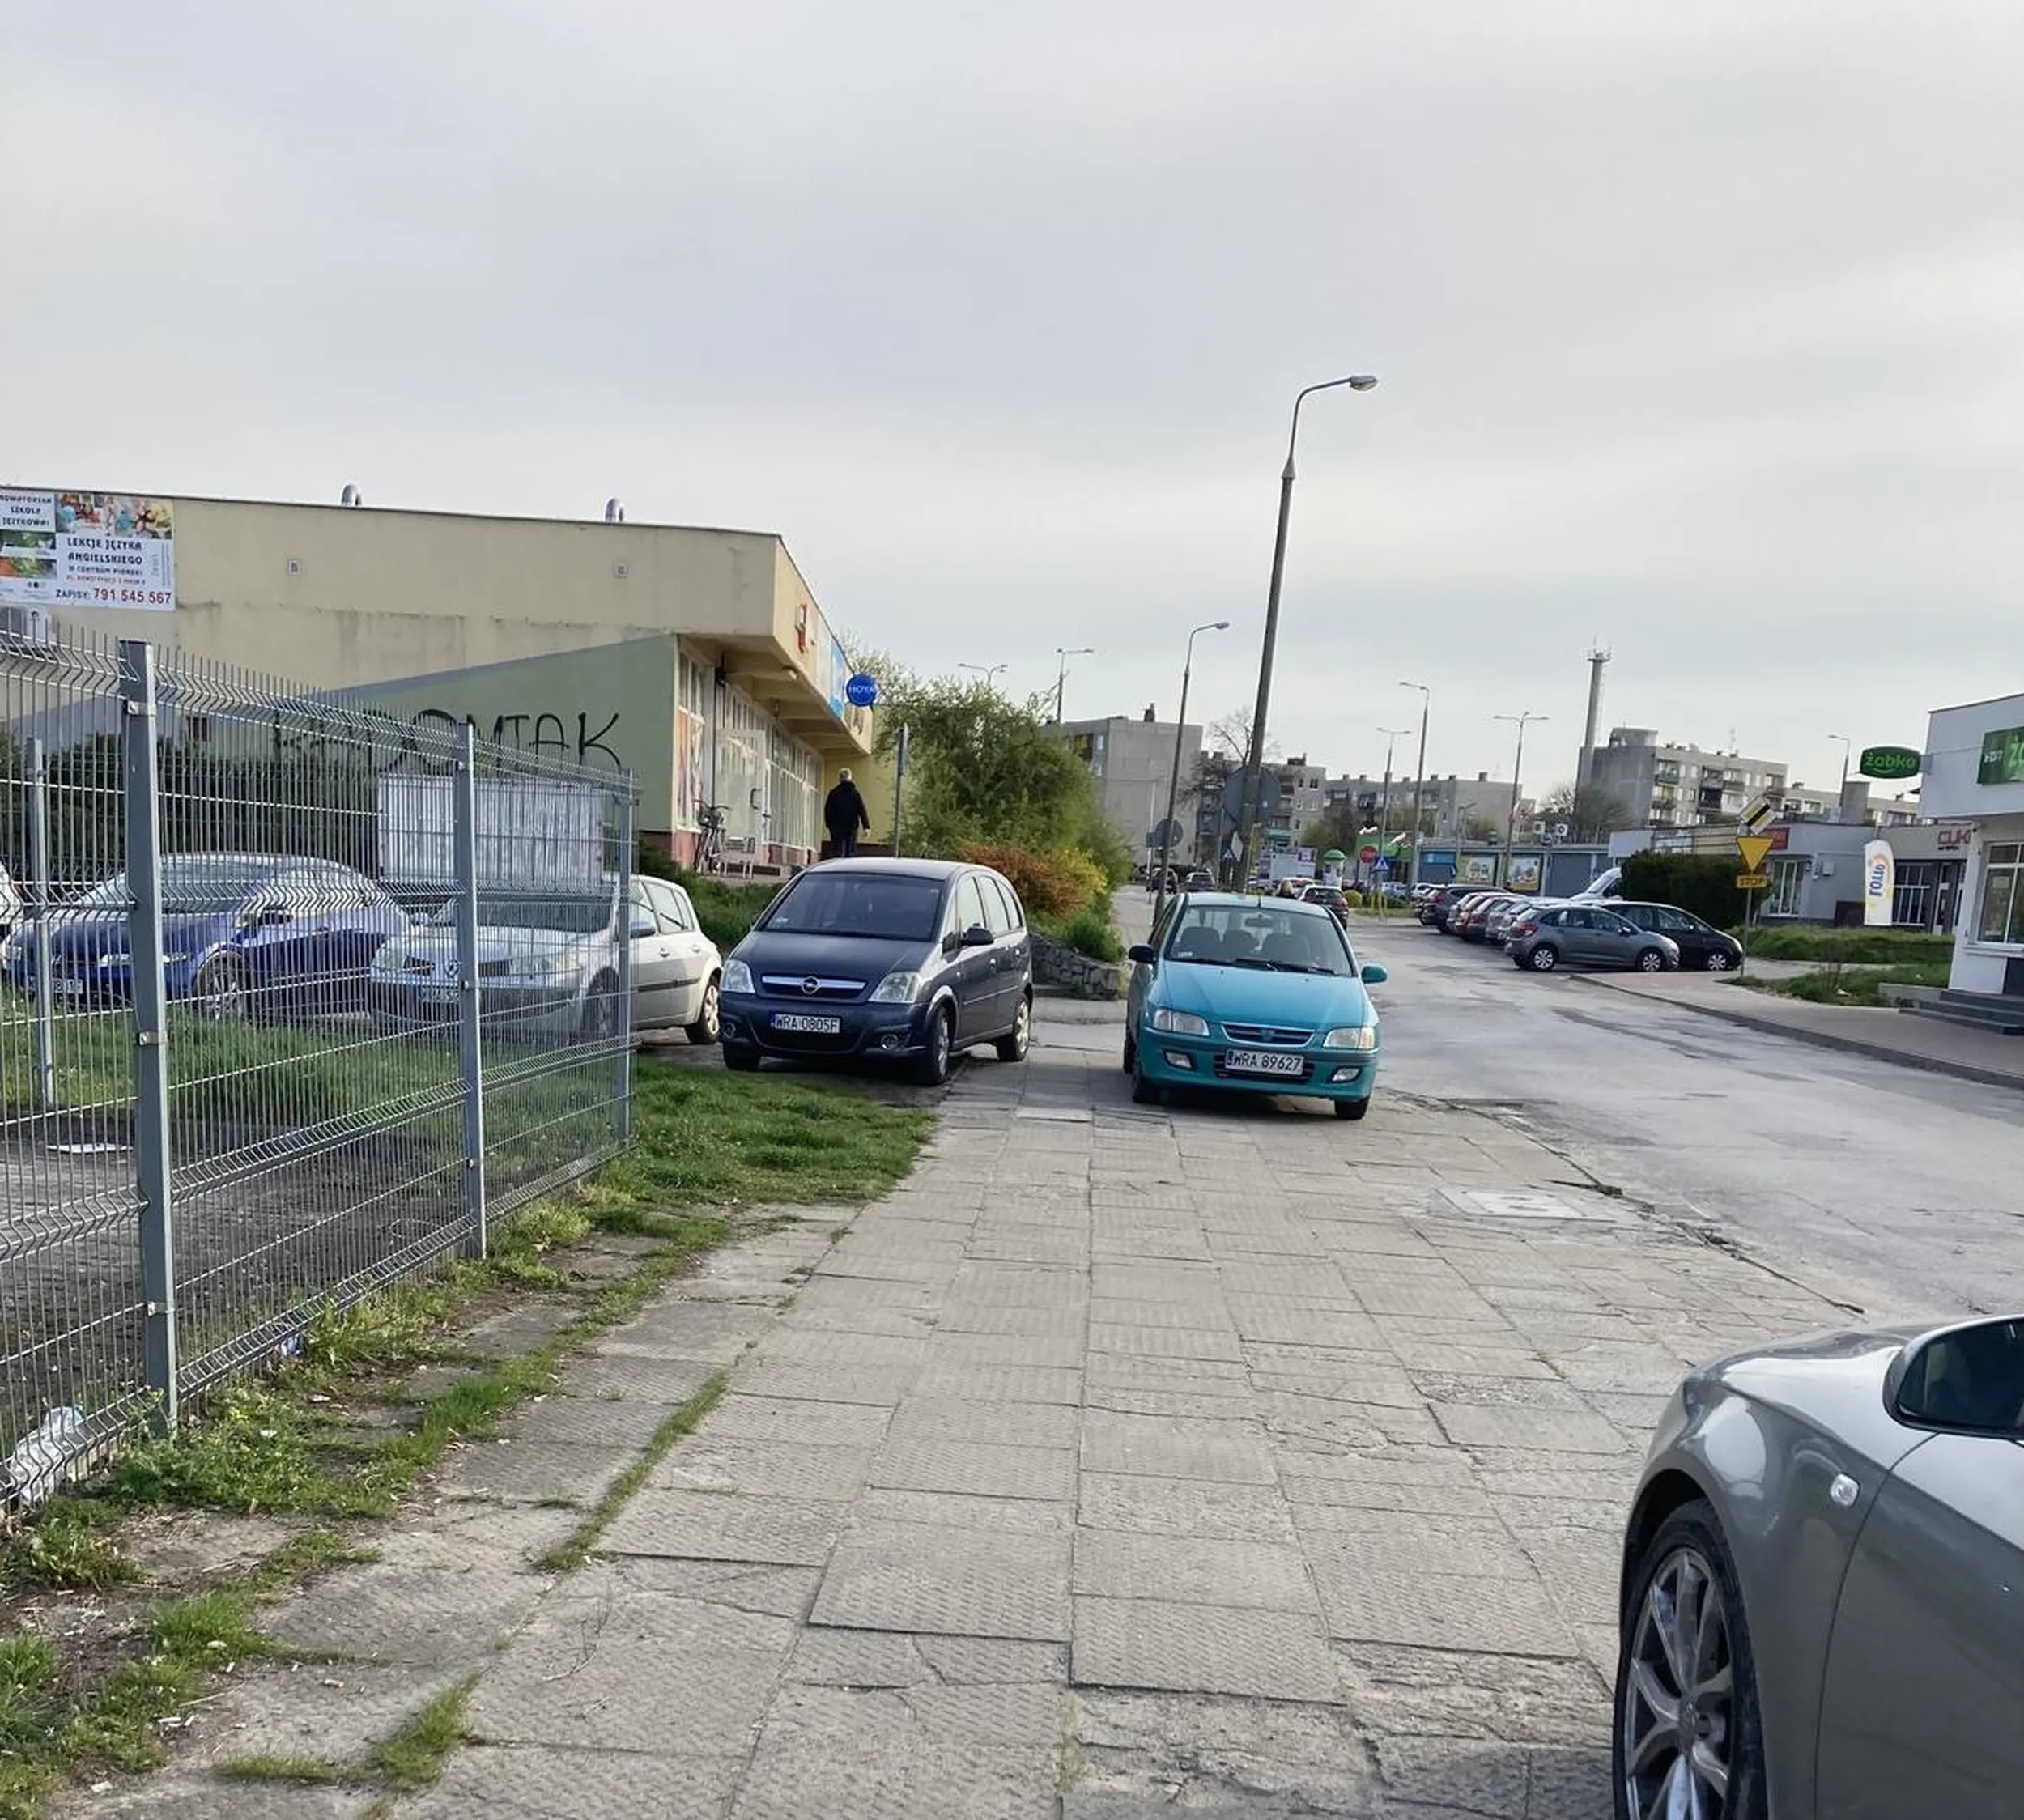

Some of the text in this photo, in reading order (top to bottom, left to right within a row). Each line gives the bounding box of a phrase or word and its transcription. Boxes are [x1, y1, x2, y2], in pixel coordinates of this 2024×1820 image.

[67, 538, 102, 550] LEKCJE
[68, 552, 142, 565] ANGIELSKIEGO
[93, 588, 116, 601] 791
[121, 589, 144, 602] 545
[149, 591, 172, 604] 567
[1261, 1054, 1302, 1072] 89627
